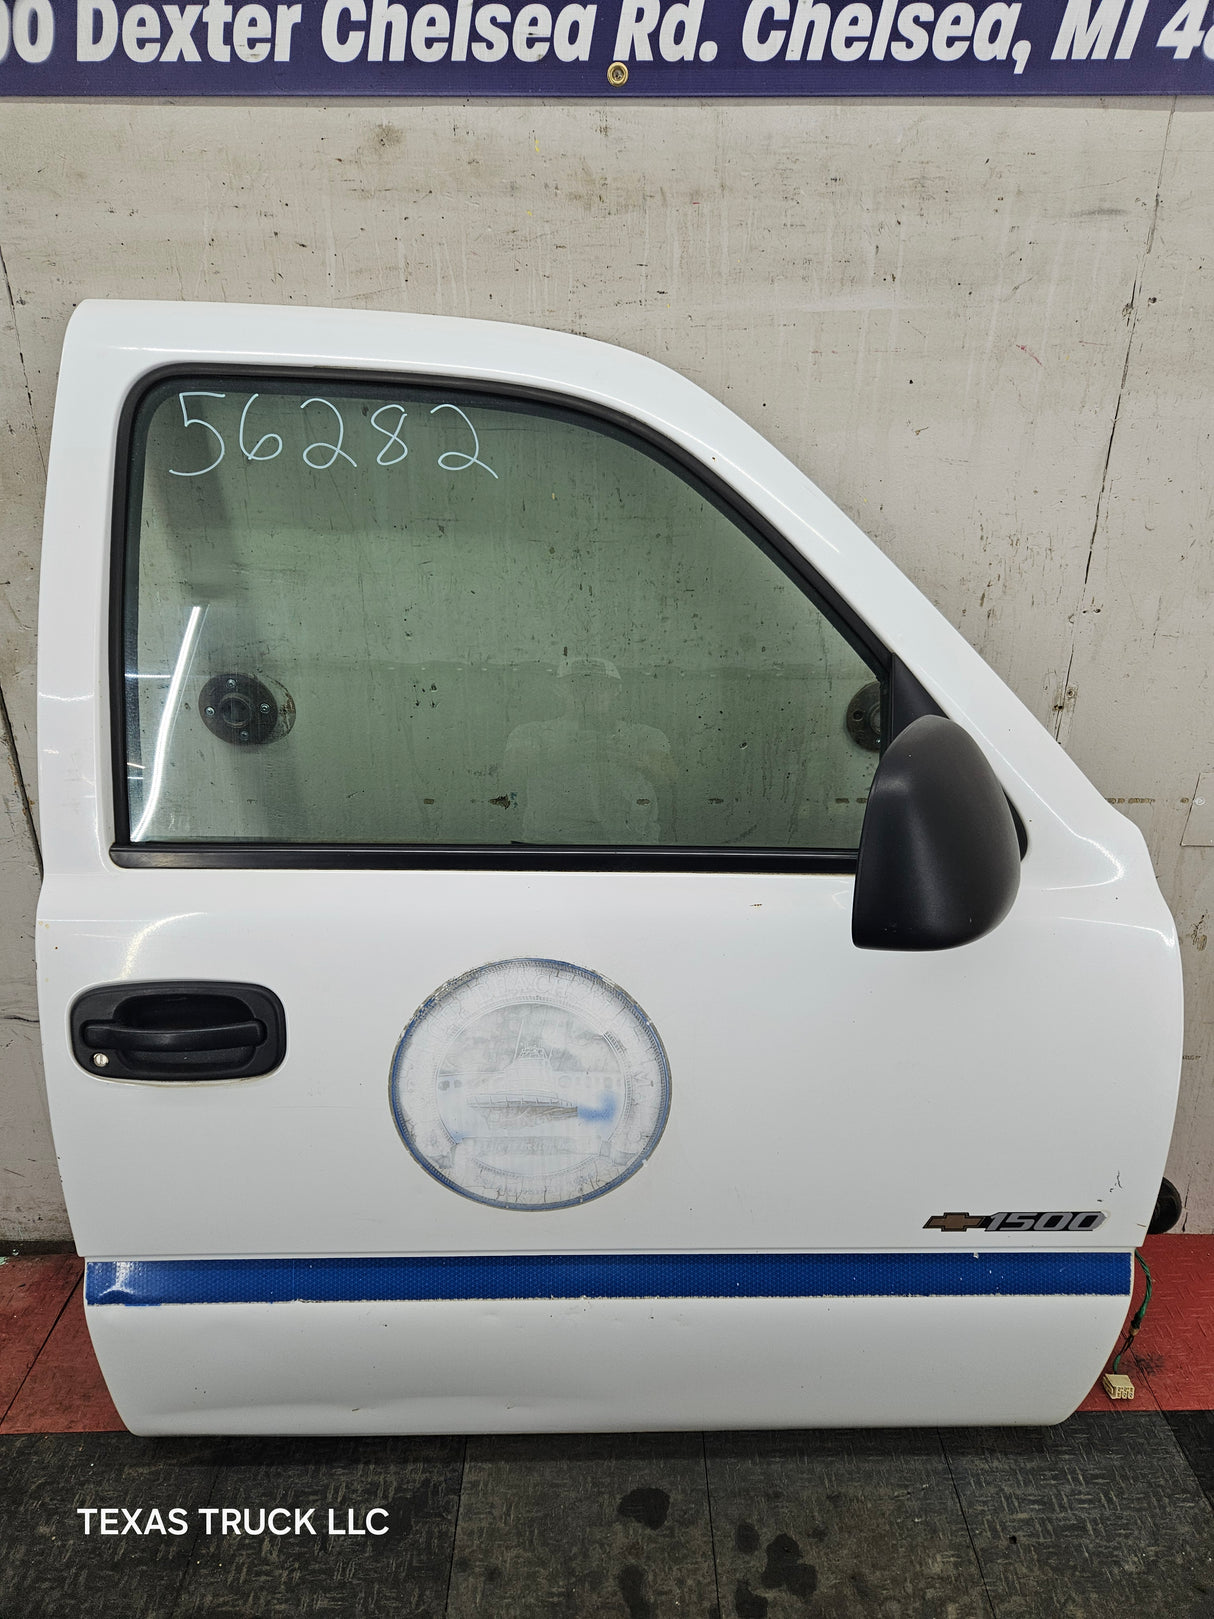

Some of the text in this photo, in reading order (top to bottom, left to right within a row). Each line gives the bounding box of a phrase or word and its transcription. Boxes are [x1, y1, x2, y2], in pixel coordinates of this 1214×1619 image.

[0, 0, 1214, 75] 0 Dexter Chelsea Rd. Chelsea, MI 4
[168, 391, 499, 480] 56282
[985, 1212, 1107, 1232] 1500
